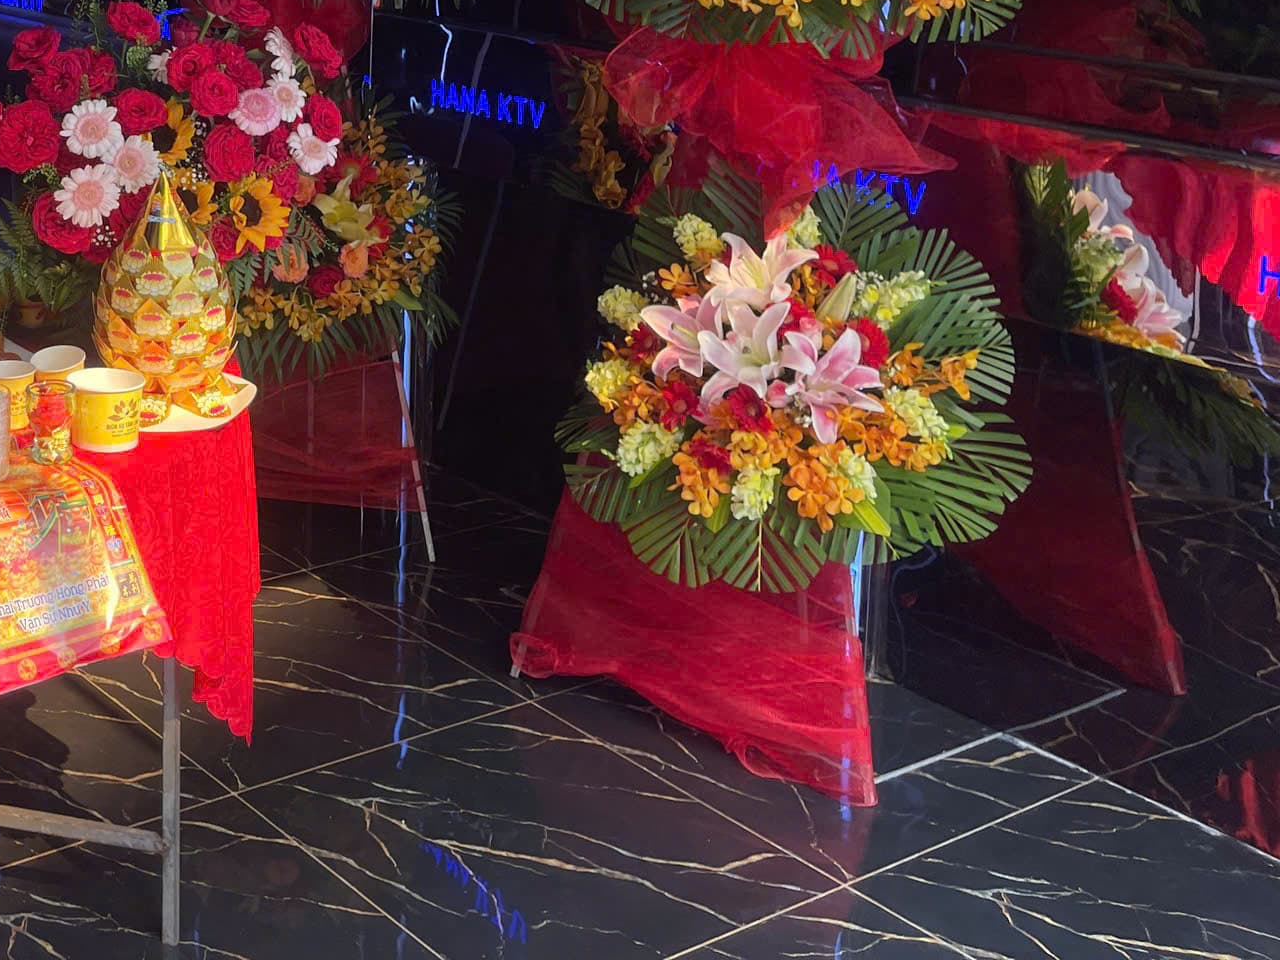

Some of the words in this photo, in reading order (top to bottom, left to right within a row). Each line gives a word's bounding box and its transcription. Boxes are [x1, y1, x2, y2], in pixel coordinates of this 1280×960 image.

[431, 78, 491, 119] HANA
[497, 92, 546, 129] KTV
[855, 167, 927, 215] KTV
